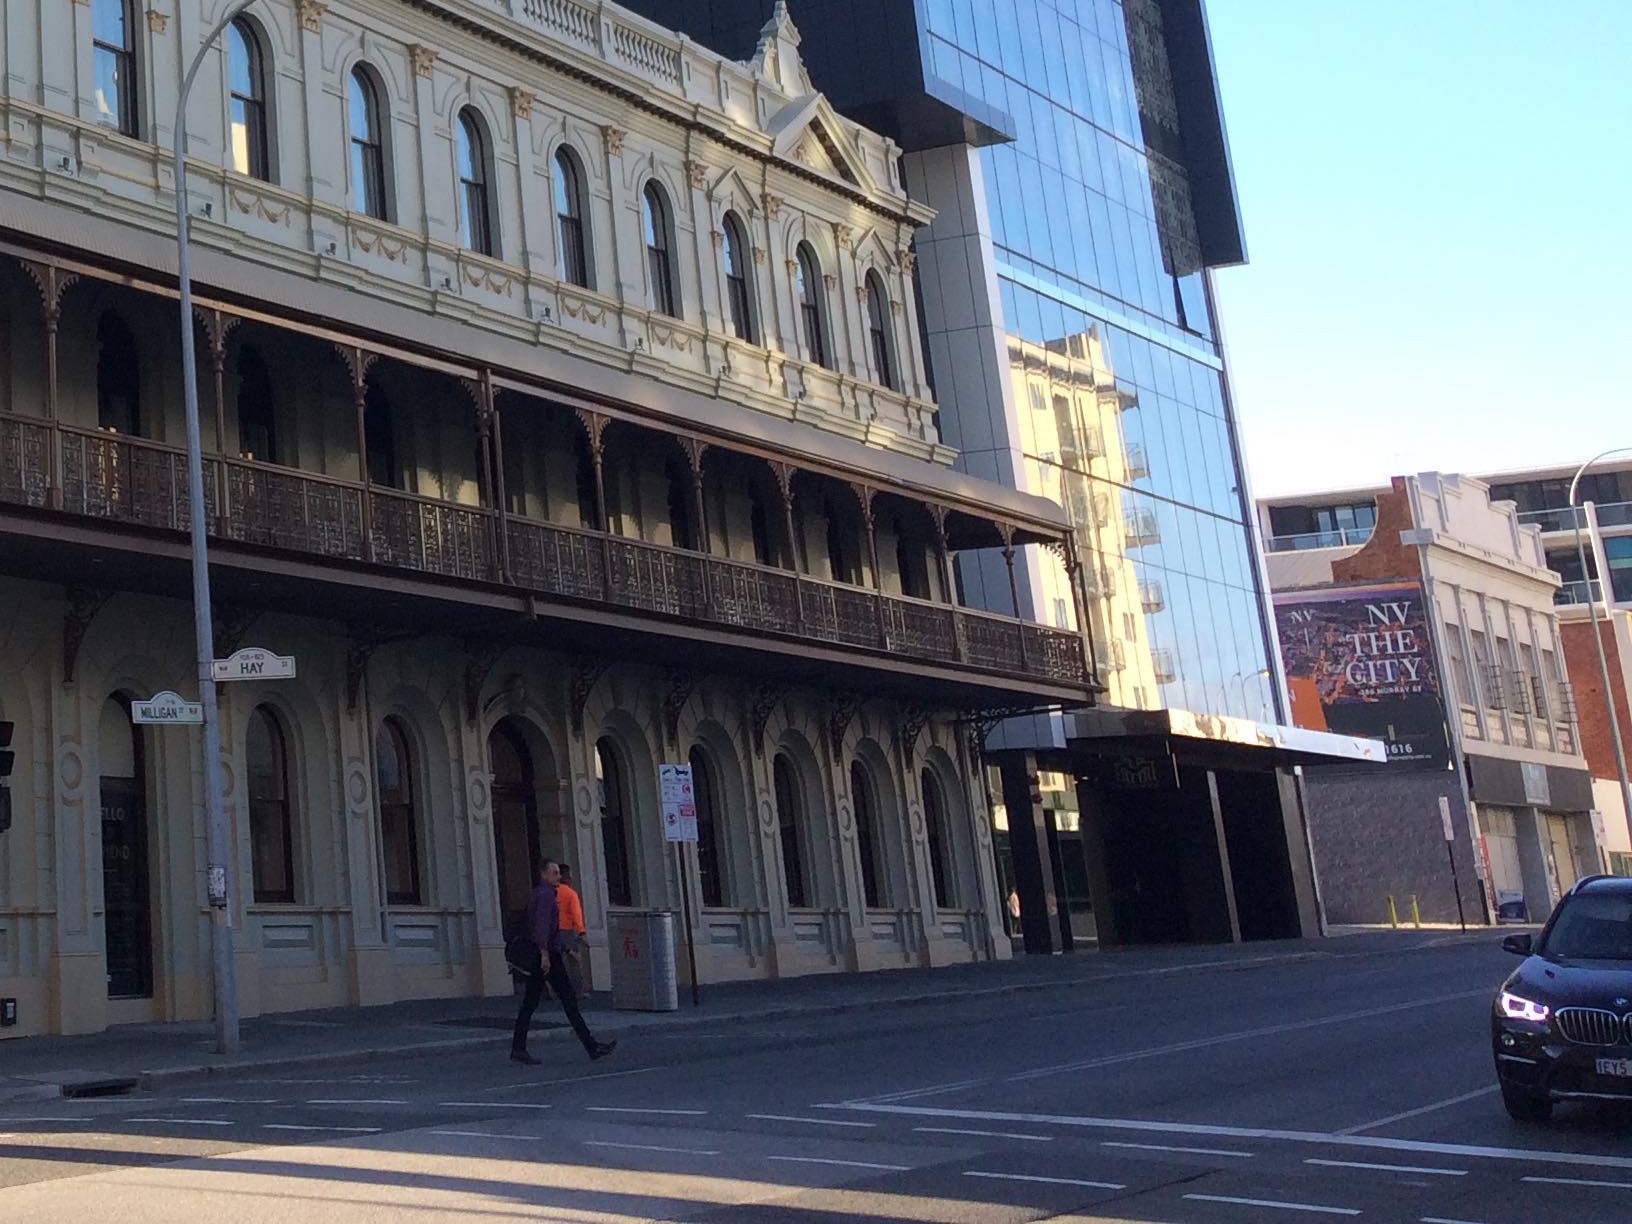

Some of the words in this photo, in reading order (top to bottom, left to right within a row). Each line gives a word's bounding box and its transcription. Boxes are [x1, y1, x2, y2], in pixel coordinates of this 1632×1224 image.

[1365, 601, 1412, 628] NV
[1346, 630, 1418, 657] THE
[240, 662, 264, 674] HAY
[1346, 657, 1422, 685] CITY
[141, 707, 178, 719] MILLIGAN
